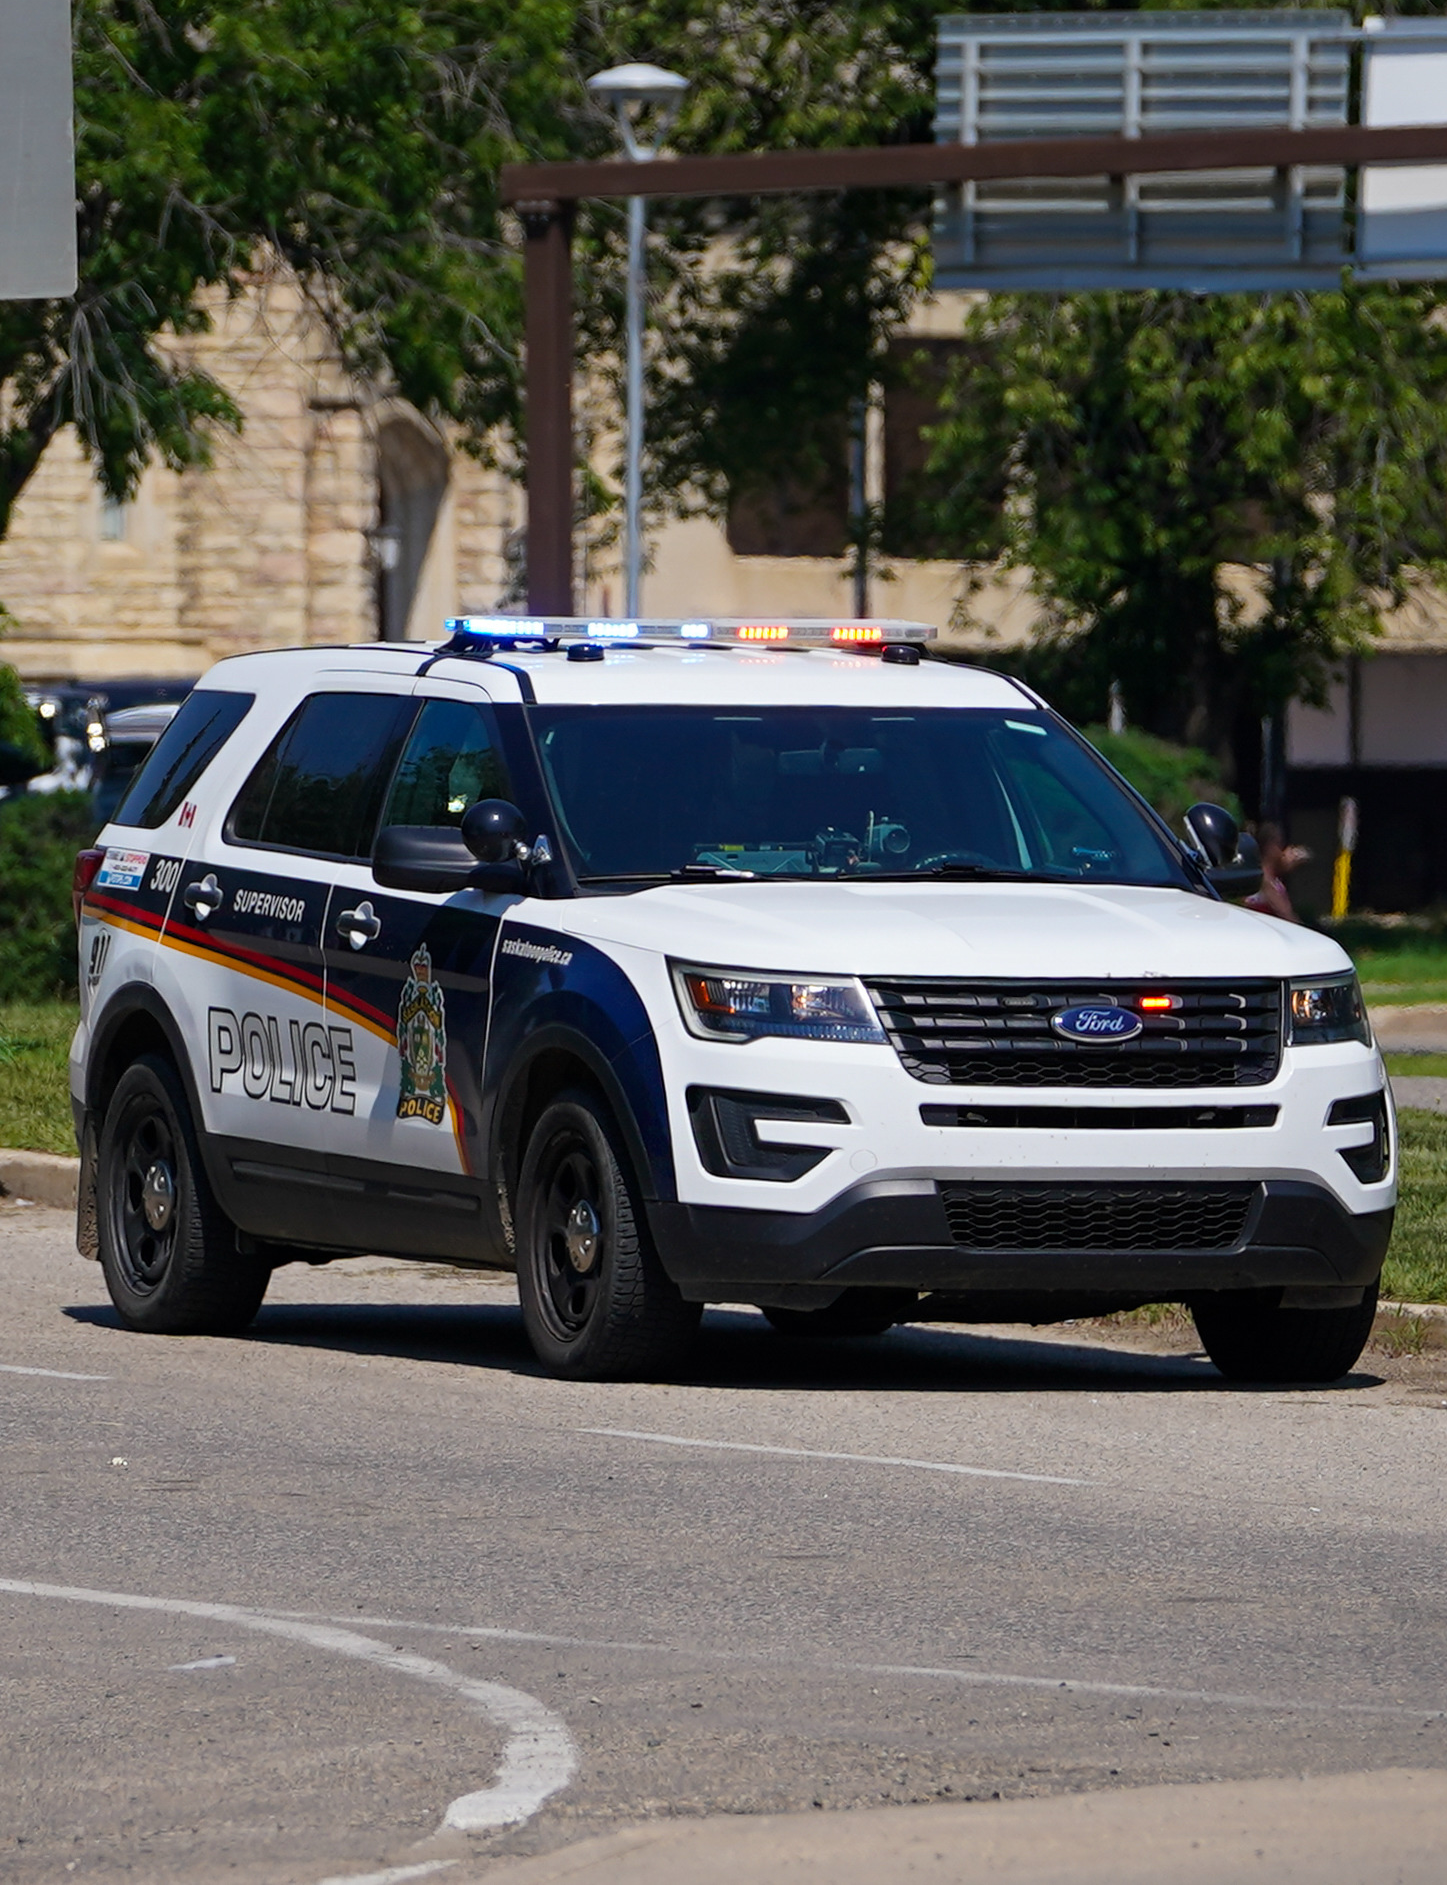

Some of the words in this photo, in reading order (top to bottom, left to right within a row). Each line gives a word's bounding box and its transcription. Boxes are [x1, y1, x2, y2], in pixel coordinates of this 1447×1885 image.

[150, 859, 179, 893] 300
[233, 889, 306, 922] SUPERVISOR
[1075, 1010, 1124, 1032] Ford
[208, 1006, 356, 1116] POLICE
[399, 1099, 442, 1123] POLICE
